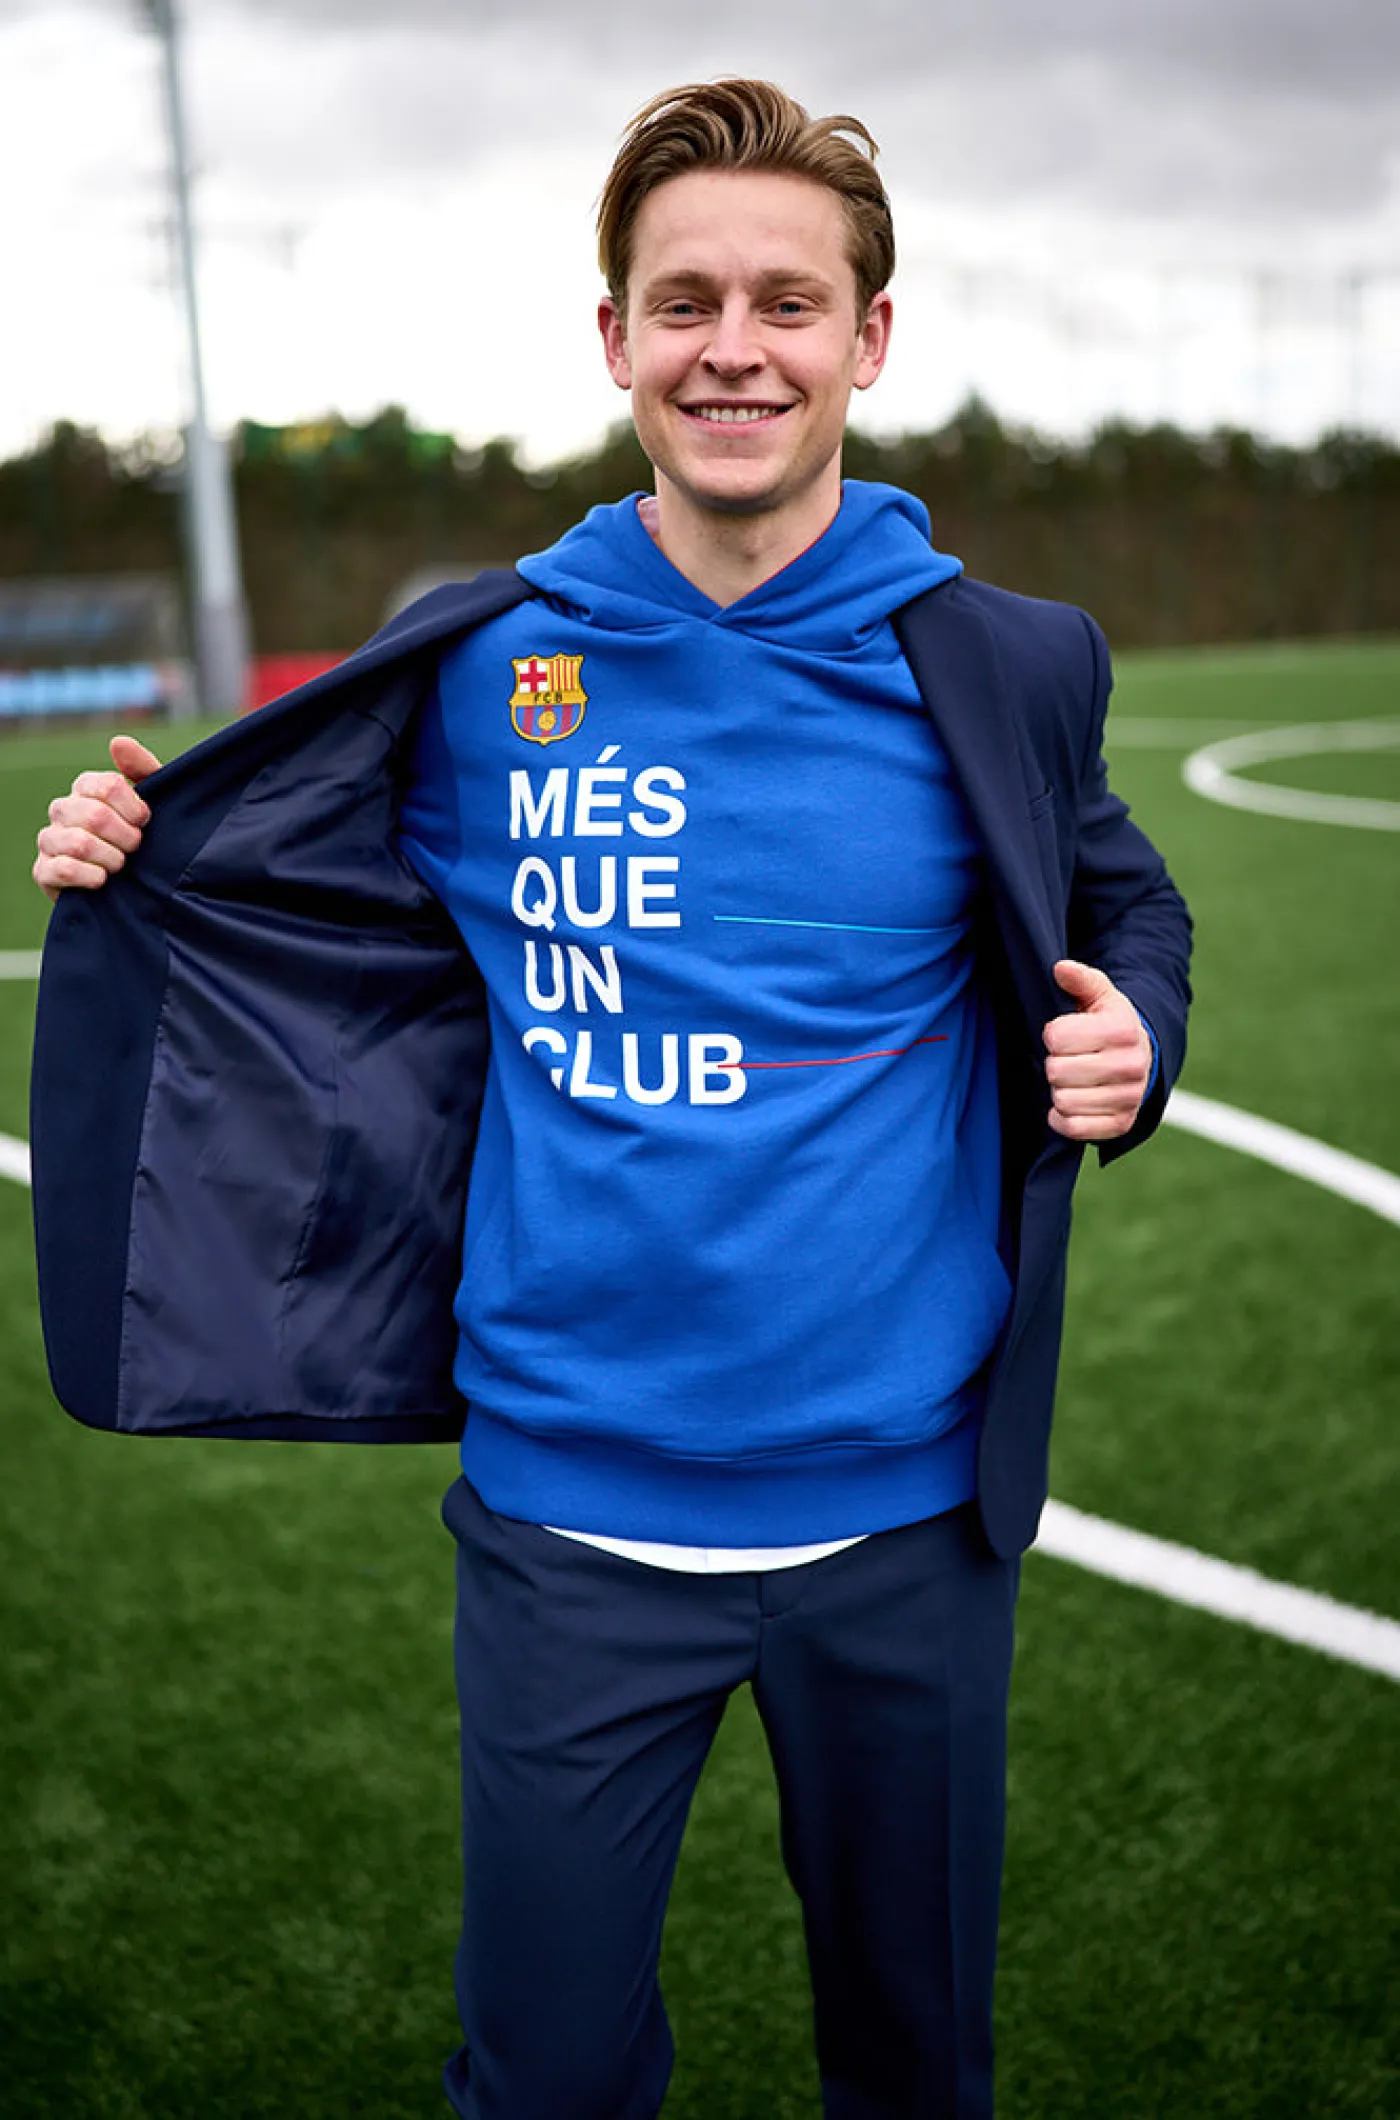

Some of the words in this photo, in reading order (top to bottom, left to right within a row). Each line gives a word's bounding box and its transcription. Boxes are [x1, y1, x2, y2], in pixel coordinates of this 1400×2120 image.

[509, 744, 687, 839] MÉS
[511, 856, 681, 932] QUE
[525, 940, 624, 1014] UN
